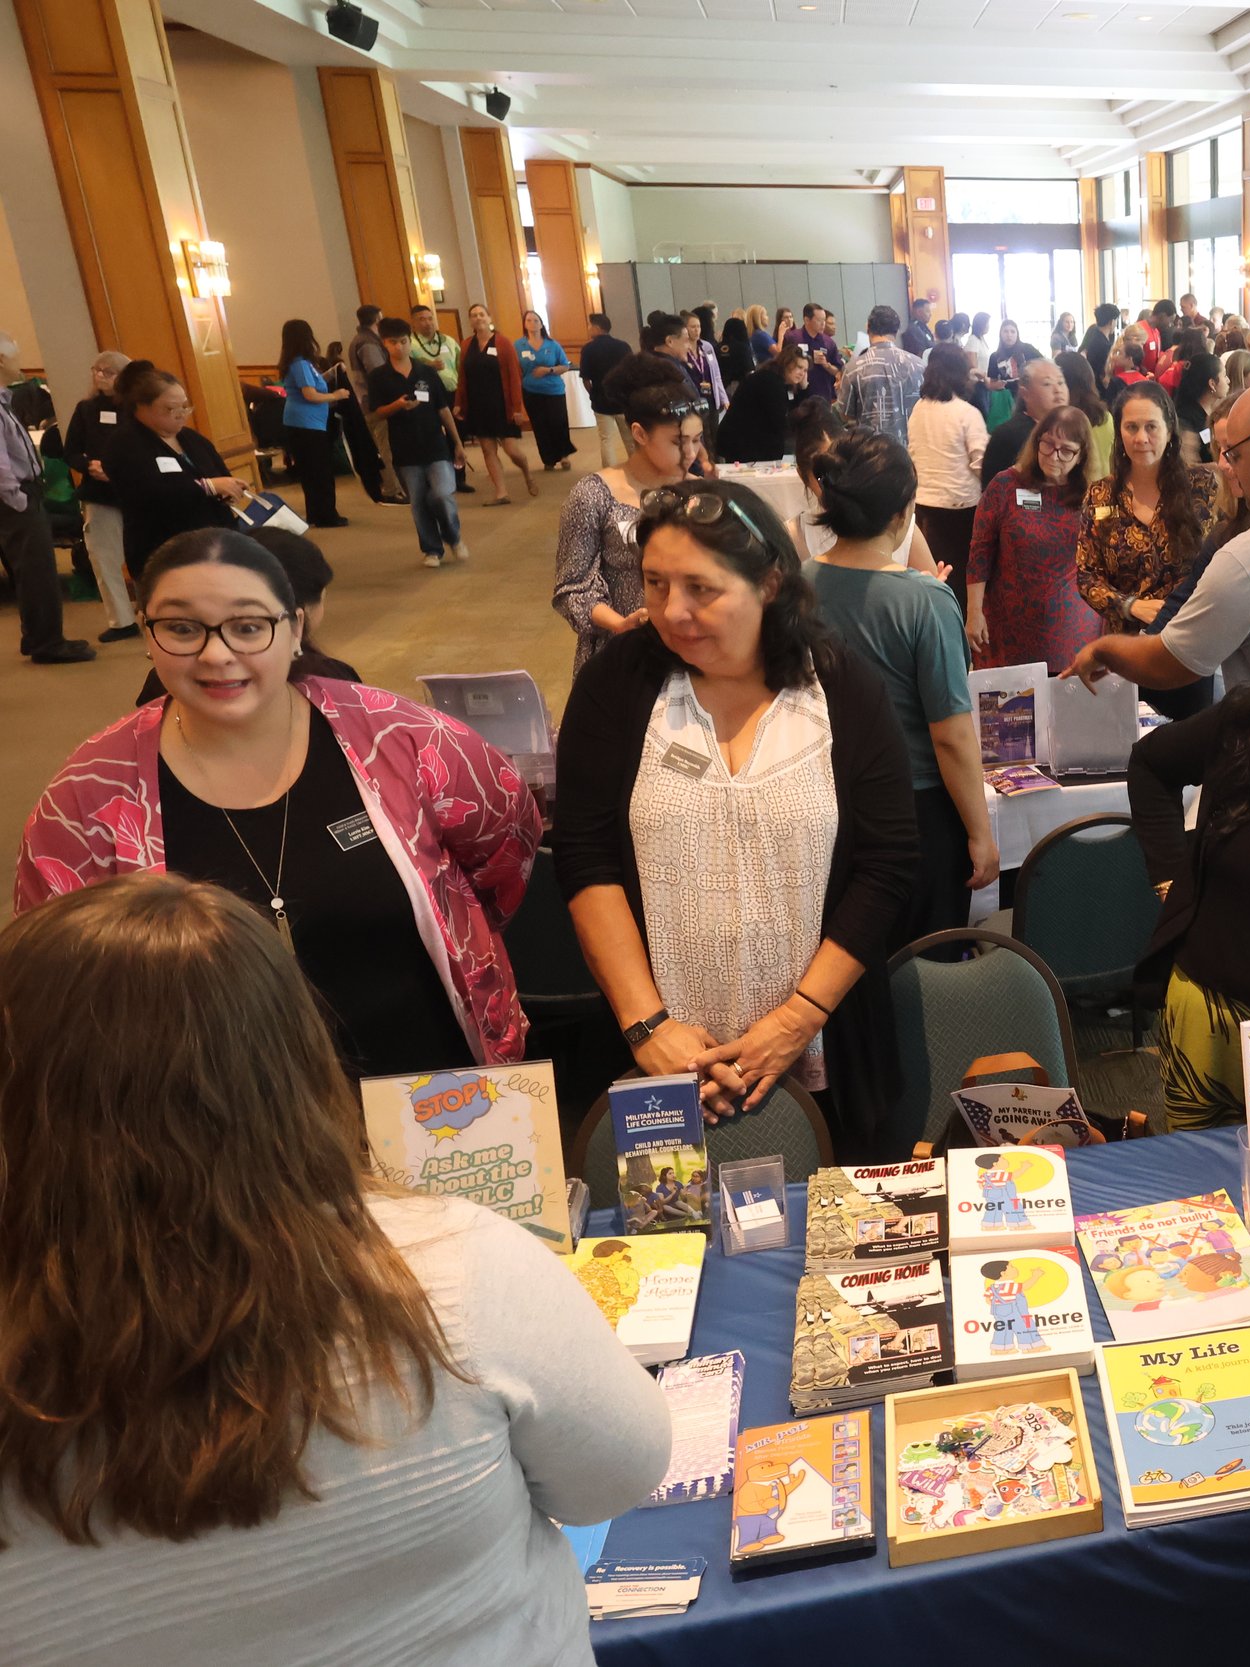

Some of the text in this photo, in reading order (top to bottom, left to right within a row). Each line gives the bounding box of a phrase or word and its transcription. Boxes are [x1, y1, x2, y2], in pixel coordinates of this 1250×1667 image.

[414, 1075, 488, 1123] STOP!
[625, 1113, 655, 1122] MILITARY
[661, 1109, 684, 1117] FAMILY
[994, 1114, 1029, 1124] GOING
[1012, 1107, 1041, 1117] PARENT
[640, 1116, 684, 1127] COUNSELING
[635, 1141, 651, 1150] CHILD
[664, 1138, 682, 1146] YOUTH
[420, 1144, 513, 1178] Ask me
[854, 1160, 935, 1179] COMING HOME
[489, 1160, 532, 1183] the
[958, 1199, 1004, 1213] Over
[1010, 1198, 1066, 1211] There
[1090, 1211, 1214, 1239] Friends do not bully!
[841, 1263, 930, 1288] COMING HOME
[964, 1318, 1015, 1334] Over
[1021, 1311, 1083, 1329] There
[1139, 1342, 1240, 1367] My Life
[1194, 1361, 1220, 1373] kid's
[615, 1564, 647, 1572] Recovery
[655, 1563, 686, 1572] possible.
